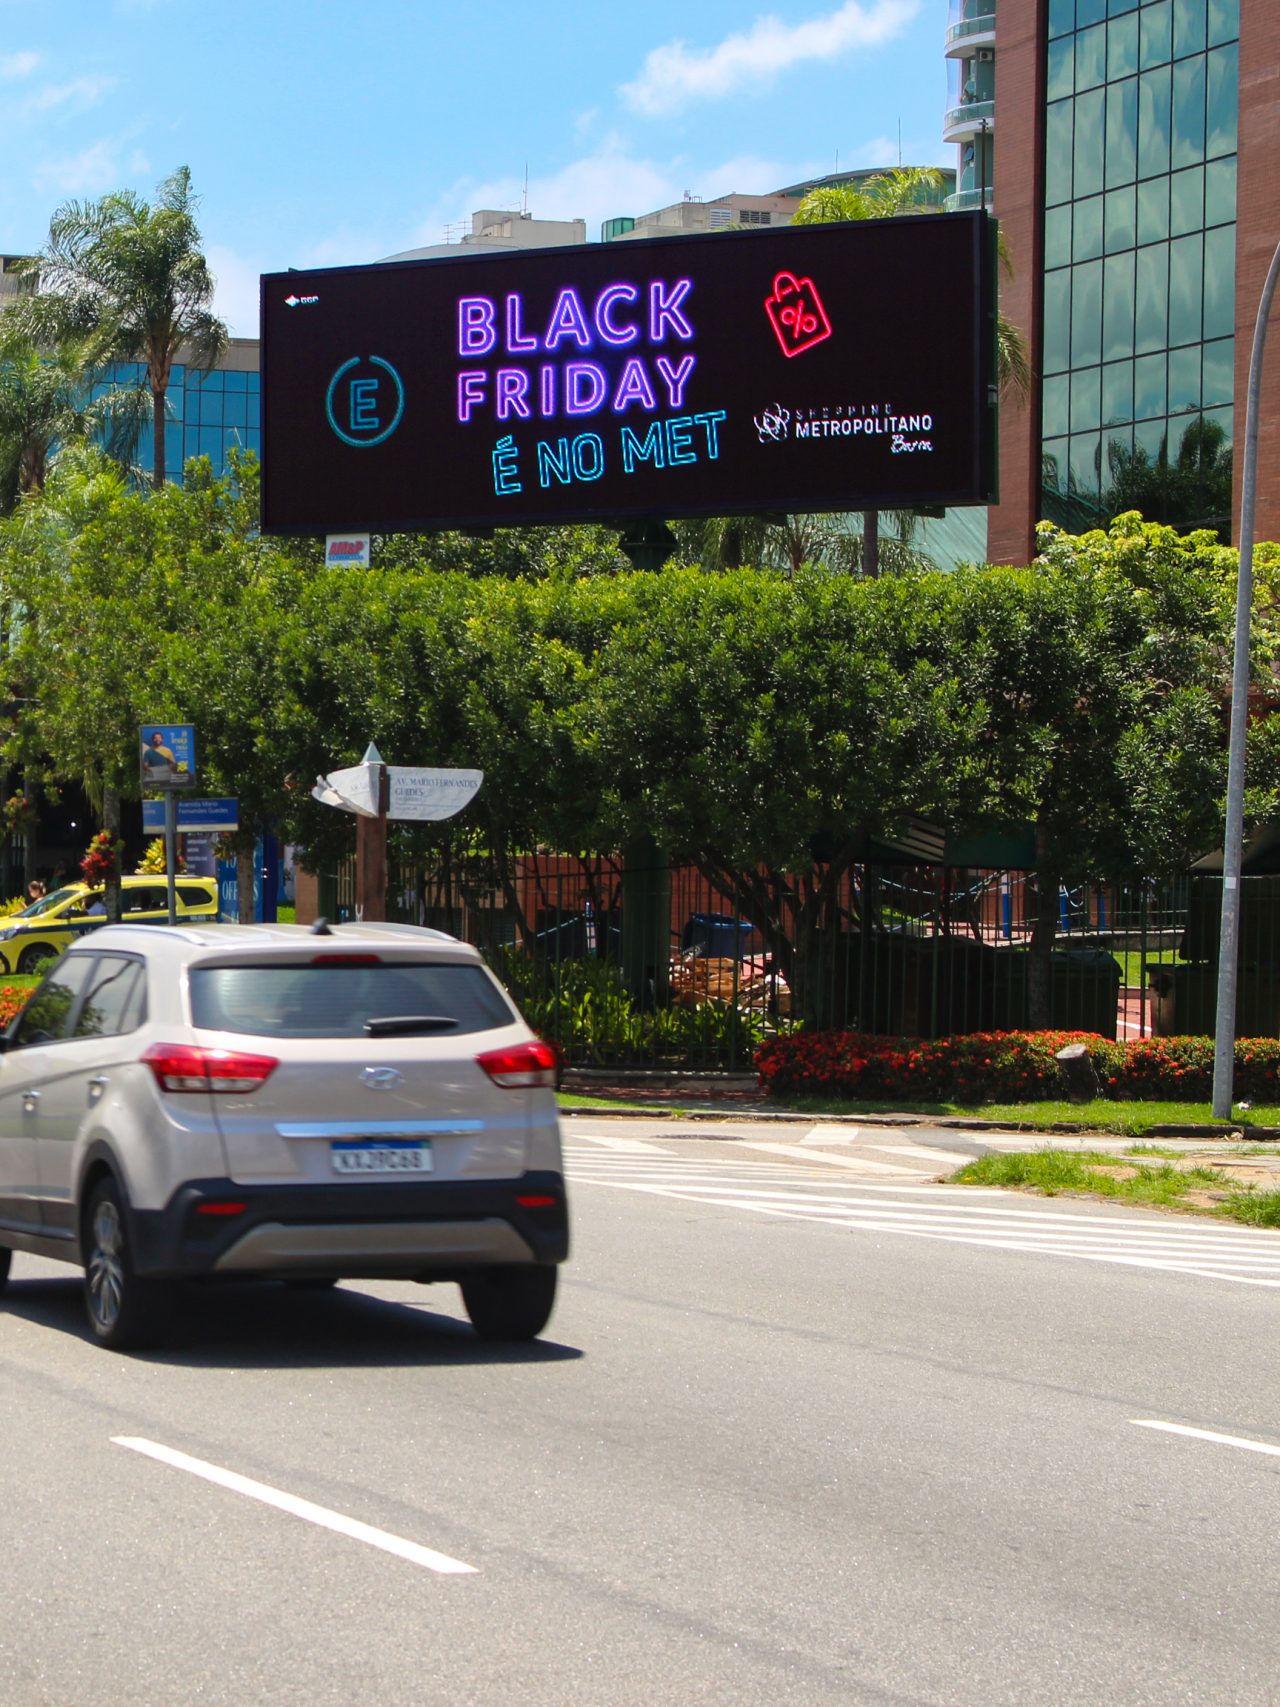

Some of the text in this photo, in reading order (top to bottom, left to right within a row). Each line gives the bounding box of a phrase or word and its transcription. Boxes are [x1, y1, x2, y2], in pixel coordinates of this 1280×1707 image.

[459, 279, 692, 356] BLACK
[458, 356, 694, 422] FRIDAY
[492, 410, 726, 495] É NO MET
[795, 414, 932, 438] METROPOLITANO
